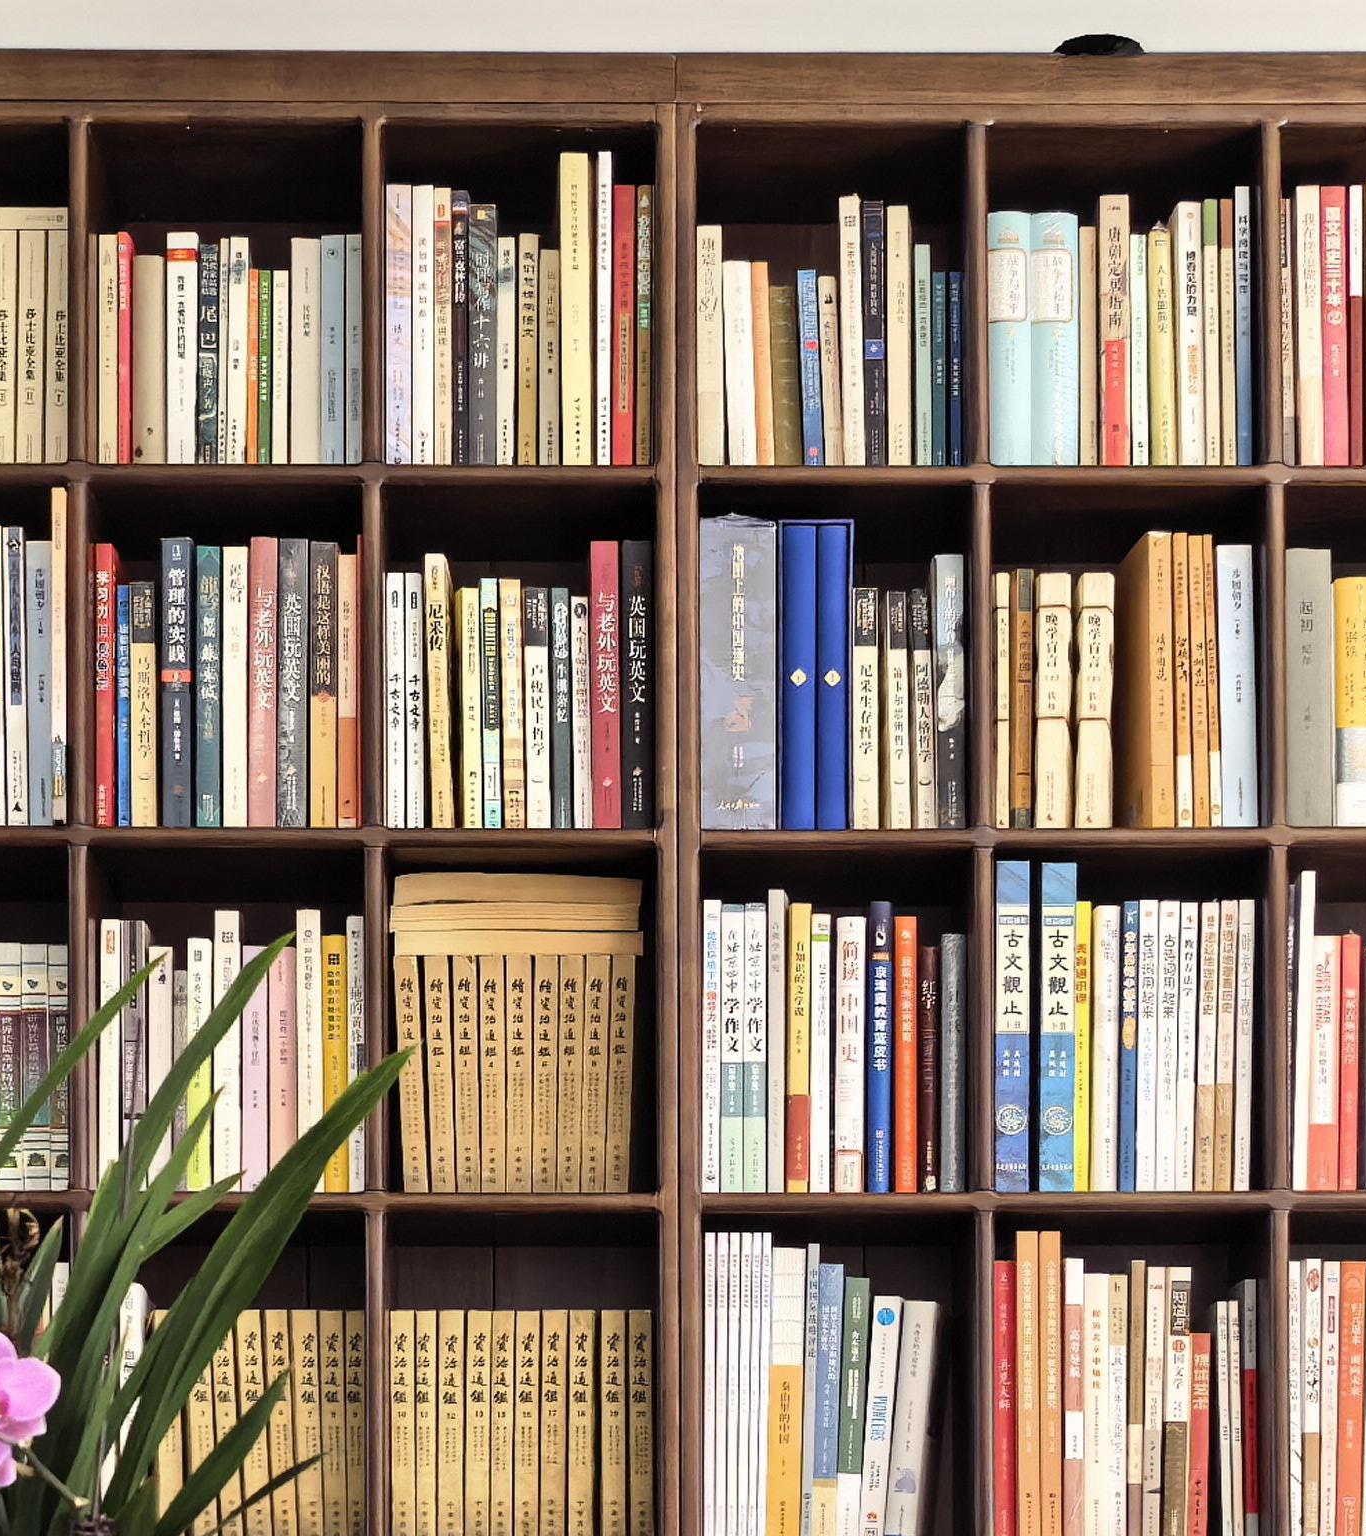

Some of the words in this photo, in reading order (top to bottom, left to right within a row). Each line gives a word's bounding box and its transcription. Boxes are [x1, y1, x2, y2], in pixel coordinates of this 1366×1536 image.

[1106, 225, 1123, 329] 唐朝定居指南
[167, 568, 186, 663] 管理的实践
[254, 589, 273, 710] 与老外玩英文
[283, 594, 301, 702] 英国玩英文
[428, 602, 444, 652] 尼采传
[597, 591, 617, 714] 与老外玩英文
[628, 595, 646, 704] 英国玩英文
[859, 663, 874, 755] 尼采生存哲学
[841, 940, 859, 1064] 简读中国史
[1002, 927, 1023, 1018] 古文觀止
[1048, 927, 1070, 1018] 古文觀止
[416, 1333, 431, 1405] 資治通鑑
[471, 1333, 486, 1405] 資治通鑑
[521, 1333, 536, 1405] 資治通鑑
[574, 1333, 589, 1405] 資治通鑑
[633, 1333, 648, 1405] 資治通鑑
